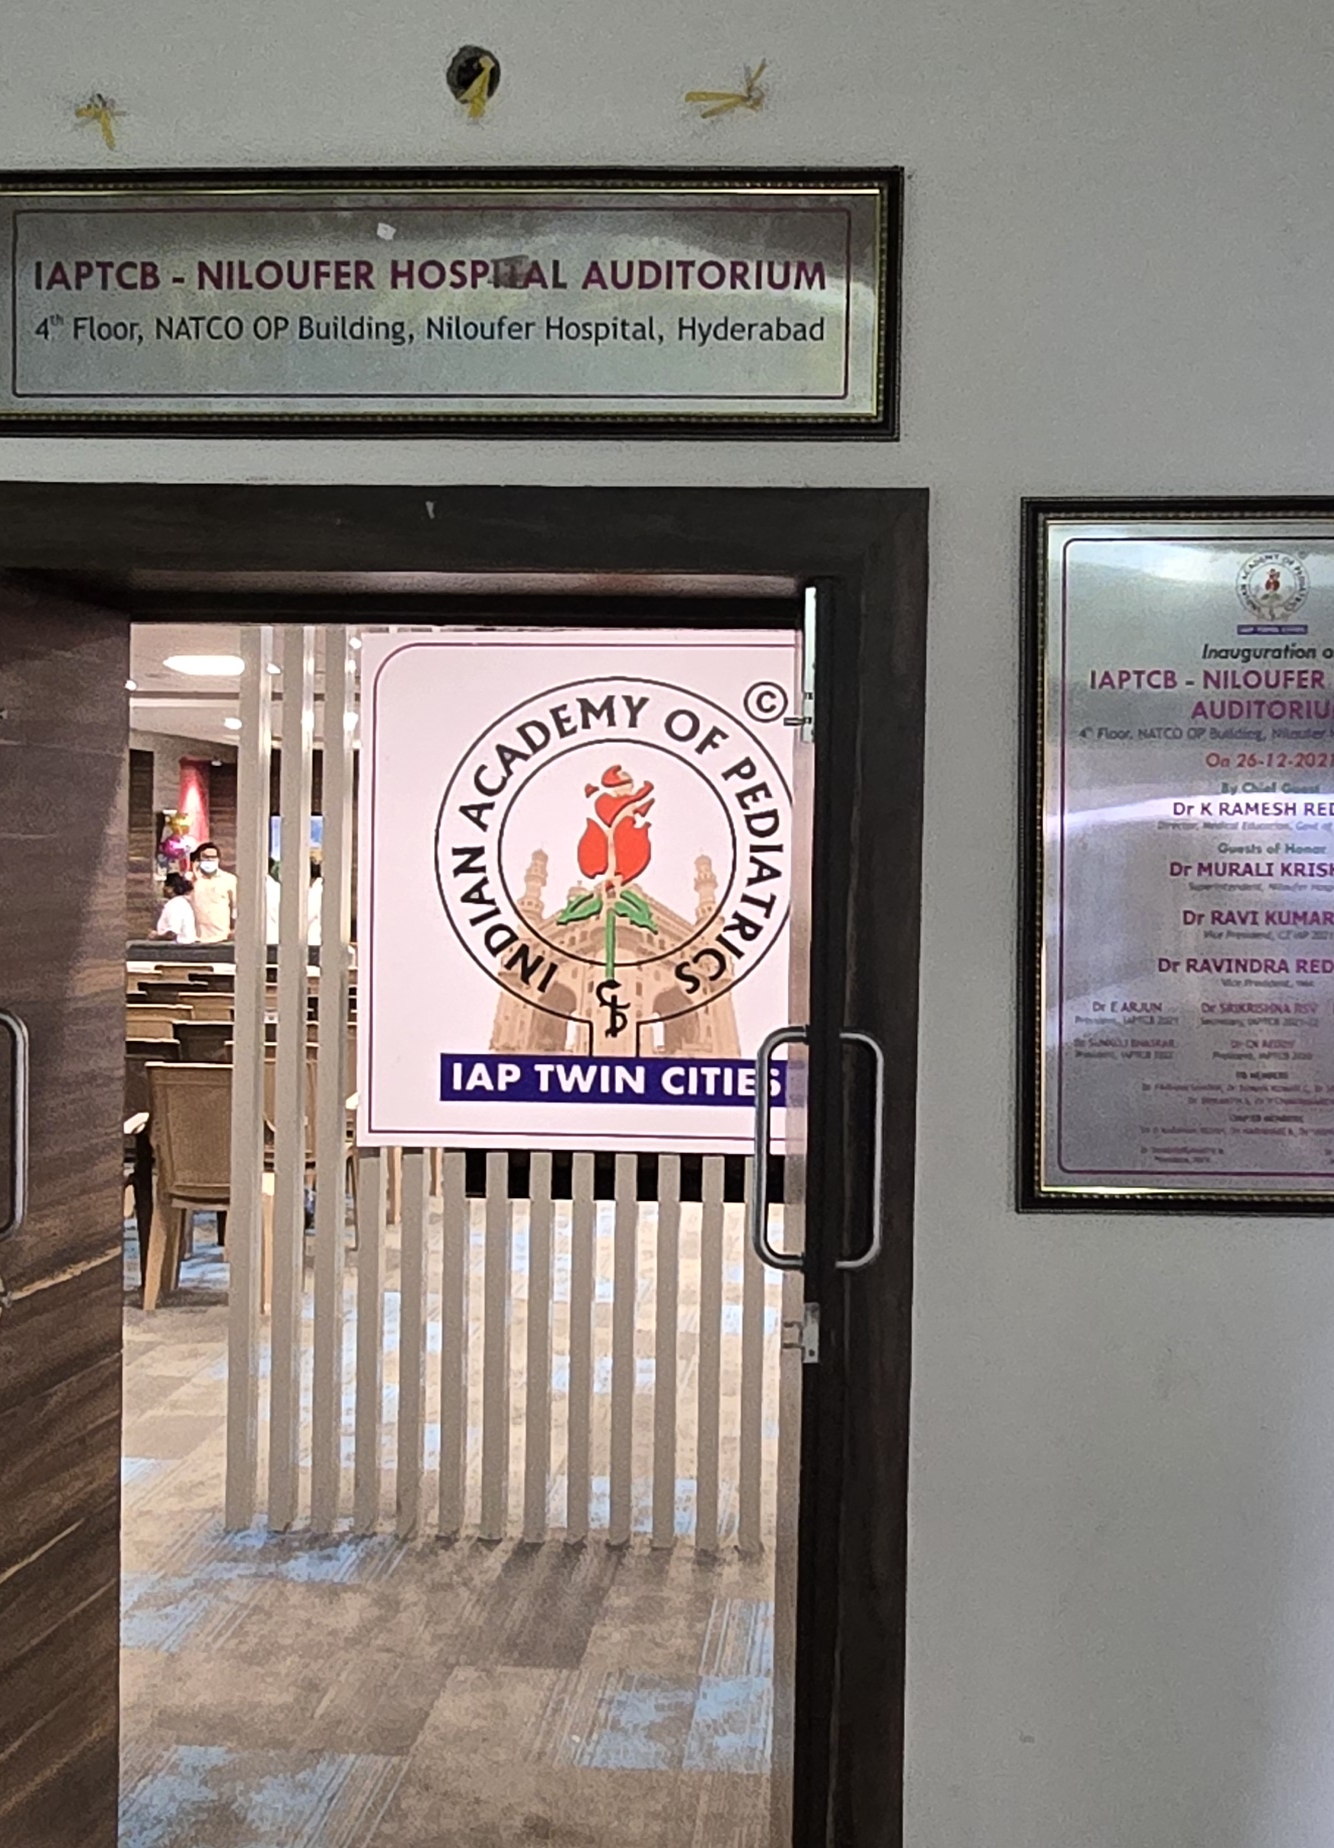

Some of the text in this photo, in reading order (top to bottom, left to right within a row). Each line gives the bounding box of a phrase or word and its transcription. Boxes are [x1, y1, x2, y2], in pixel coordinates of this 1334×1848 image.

[34, 260, 161, 291] IAPTCB
[171, 276, 185, 284] -
[197, 260, 376, 291] NILOUFER
[581, 259, 827, 291] AUDITORIUM
[73, 315, 144, 346] Floor,
[155, 315, 244, 341] NATCO
[253, 316, 289, 341] OP
[297, 315, 415, 346] Building,
[426, 316, 536, 341] Niloufer
[545, 316, 665, 347] Hospital,
[676, 316, 825, 346] Hyderabad
[1201, 643, 1317, 663] Inauguration
[1089, 669, 1178, 690] IAPTCB
[1202, 669, 1326, 690] NILOUFER
[1205, 752, 1231, 768] On
[1172, 802, 1195, 817] Dr
[1200, 802, 1213, 817] K
[1219, 802, 1298, 817] RAMESH
[451, 694, 785, 995] INDIAN ACADEMY OF PEDIATRICS
[1169, 862, 1193, 878] Dr
[1197, 862, 1275, 878] MURALI
[1182, 909, 1206, 926] Dr
[1210, 910, 1260, 926] RAVI
[1157, 957, 1181, 973] Dr
[1185, 958, 1290, 974] RAVINDRA
[451, 1062, 521, 1092] IAP
[534, 1063, 646, 1095] TWIN
